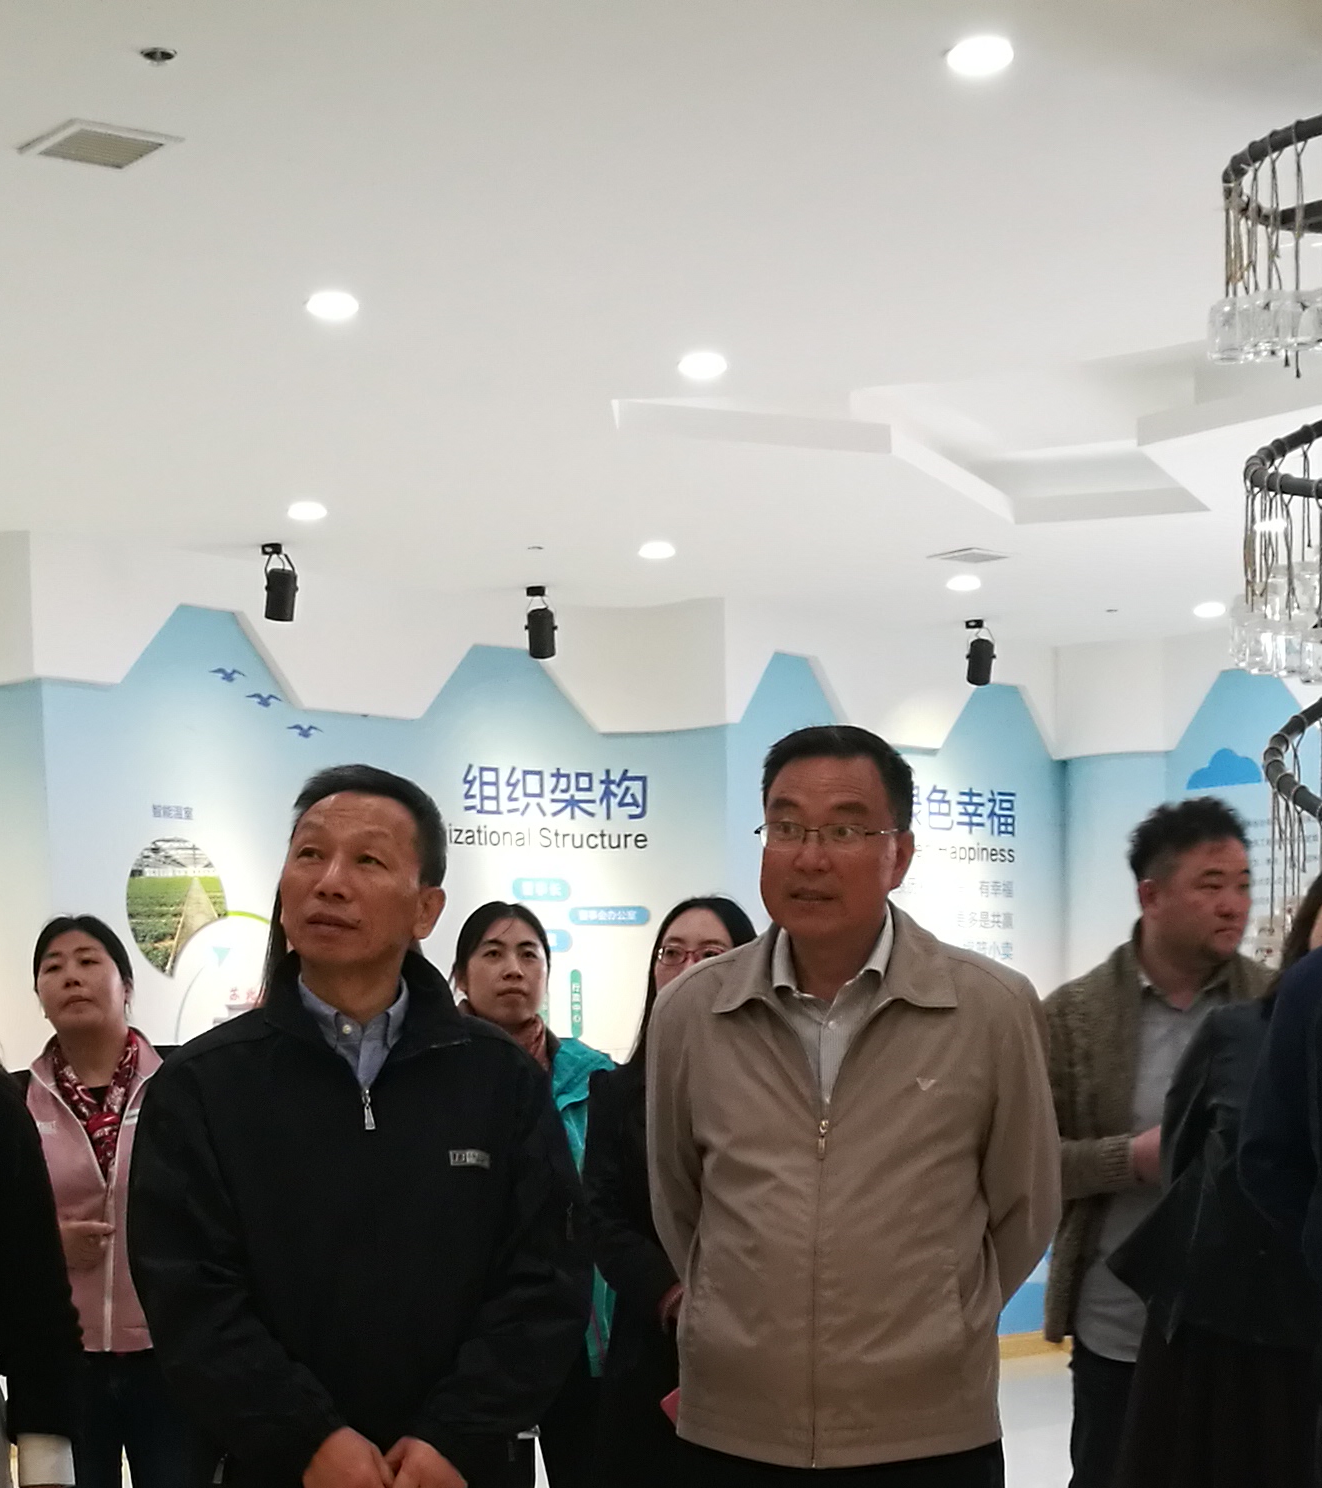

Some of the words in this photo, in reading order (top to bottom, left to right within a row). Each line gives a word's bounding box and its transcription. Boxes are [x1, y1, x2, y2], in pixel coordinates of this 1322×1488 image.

[462, 763, 649, 821] 组织架构
[538, 827, 649, 850] Structure
